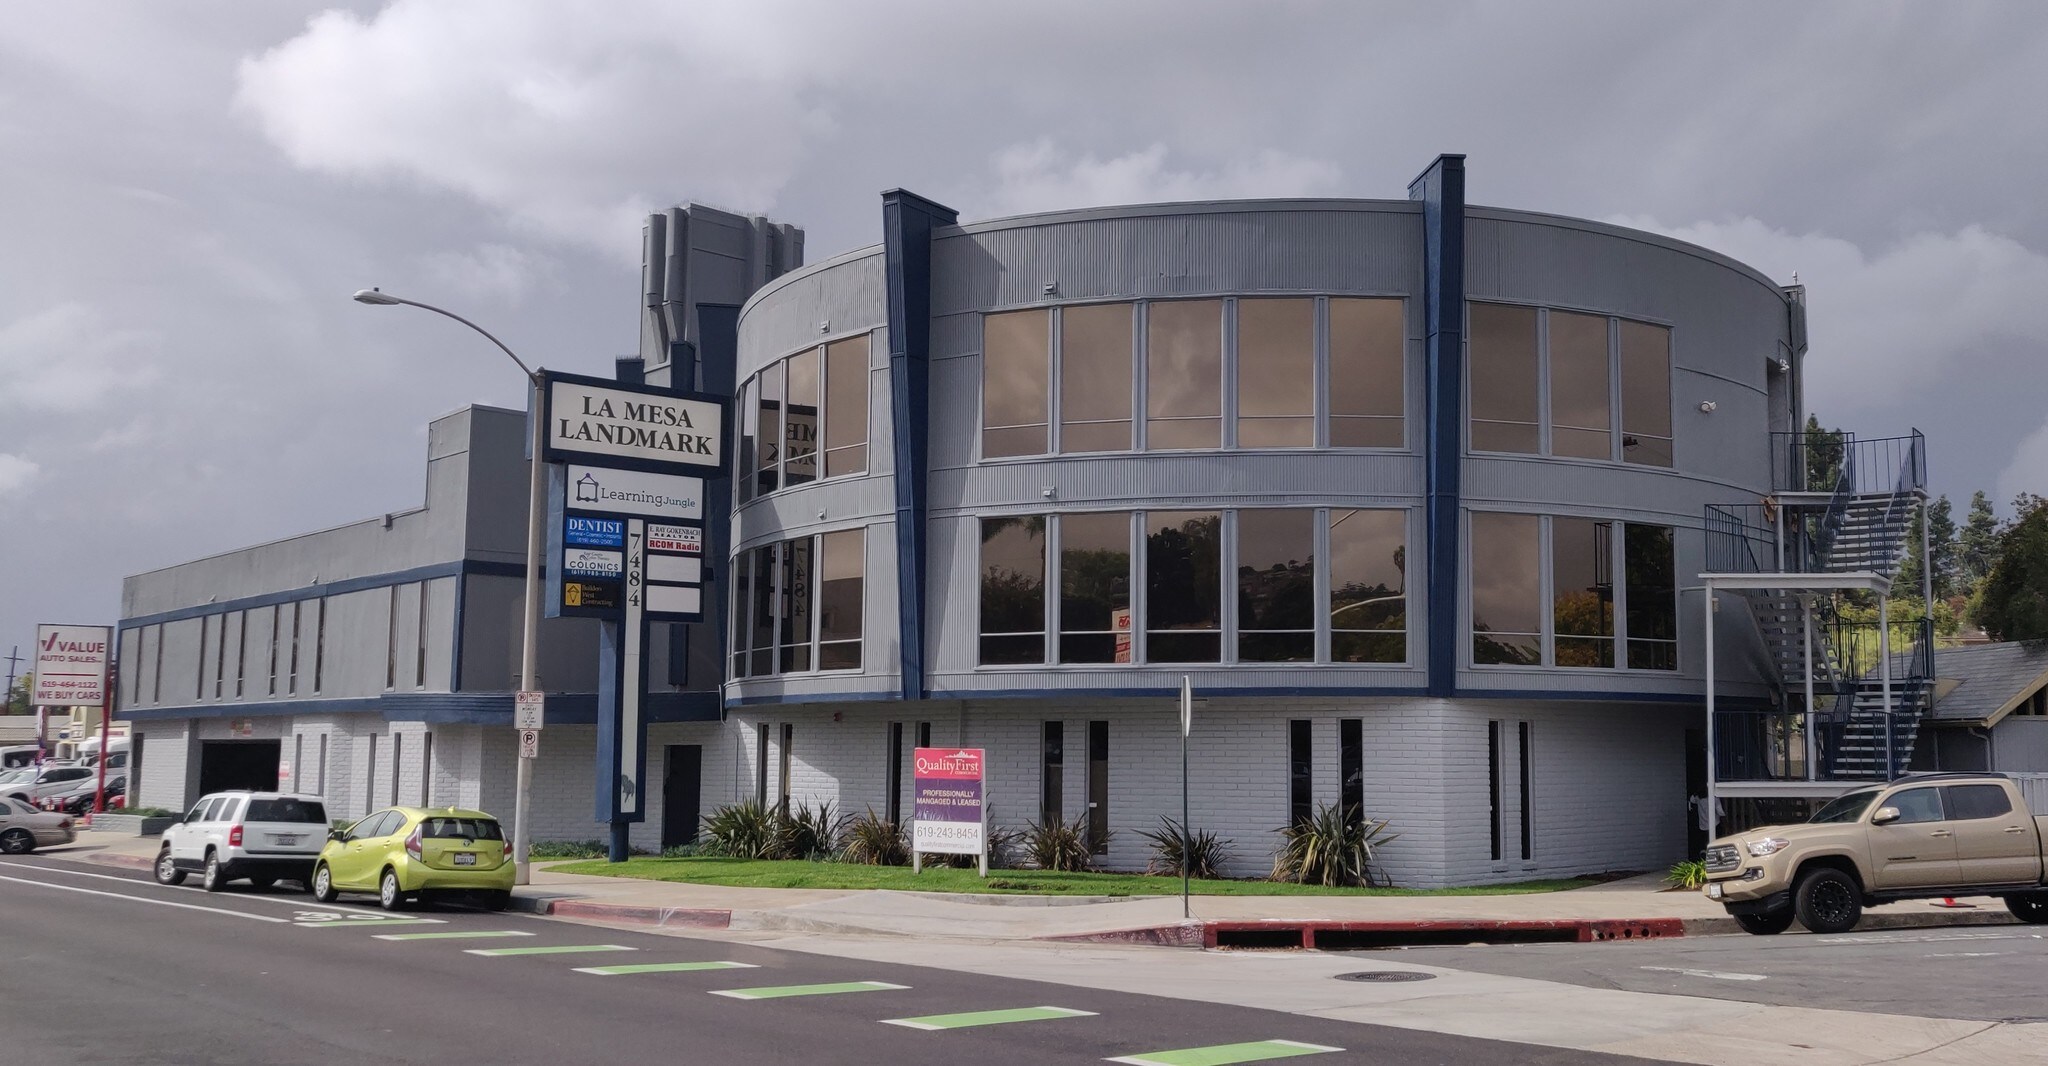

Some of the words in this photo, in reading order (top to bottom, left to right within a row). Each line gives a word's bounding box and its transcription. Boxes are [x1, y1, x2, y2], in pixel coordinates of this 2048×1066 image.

[582, 396, 616, 418] LA
[624, 401, 694, 428] MESA
[559, 418, 713, 456] LANDMARK
[569, 519, 622, 533] DENTIST
[650, 540, 674, 549] RCOM
[676, 542, 700, 551] Radio
[570, 561, 619, 571] COLONICS
[58, 641, 105, 653] VALUE
[37, 691, 53, 699] WE
[55, 691, 75, 699] BUY
[76, 691, 102, 700] CARS
[916, 757, 979, 774] QualityFirst
[922, 789, 975, 798] PROFESSIONALLY
[957, 799, 981, 807] LEASED
[916, 826, 979, 839] 619-243-8454
